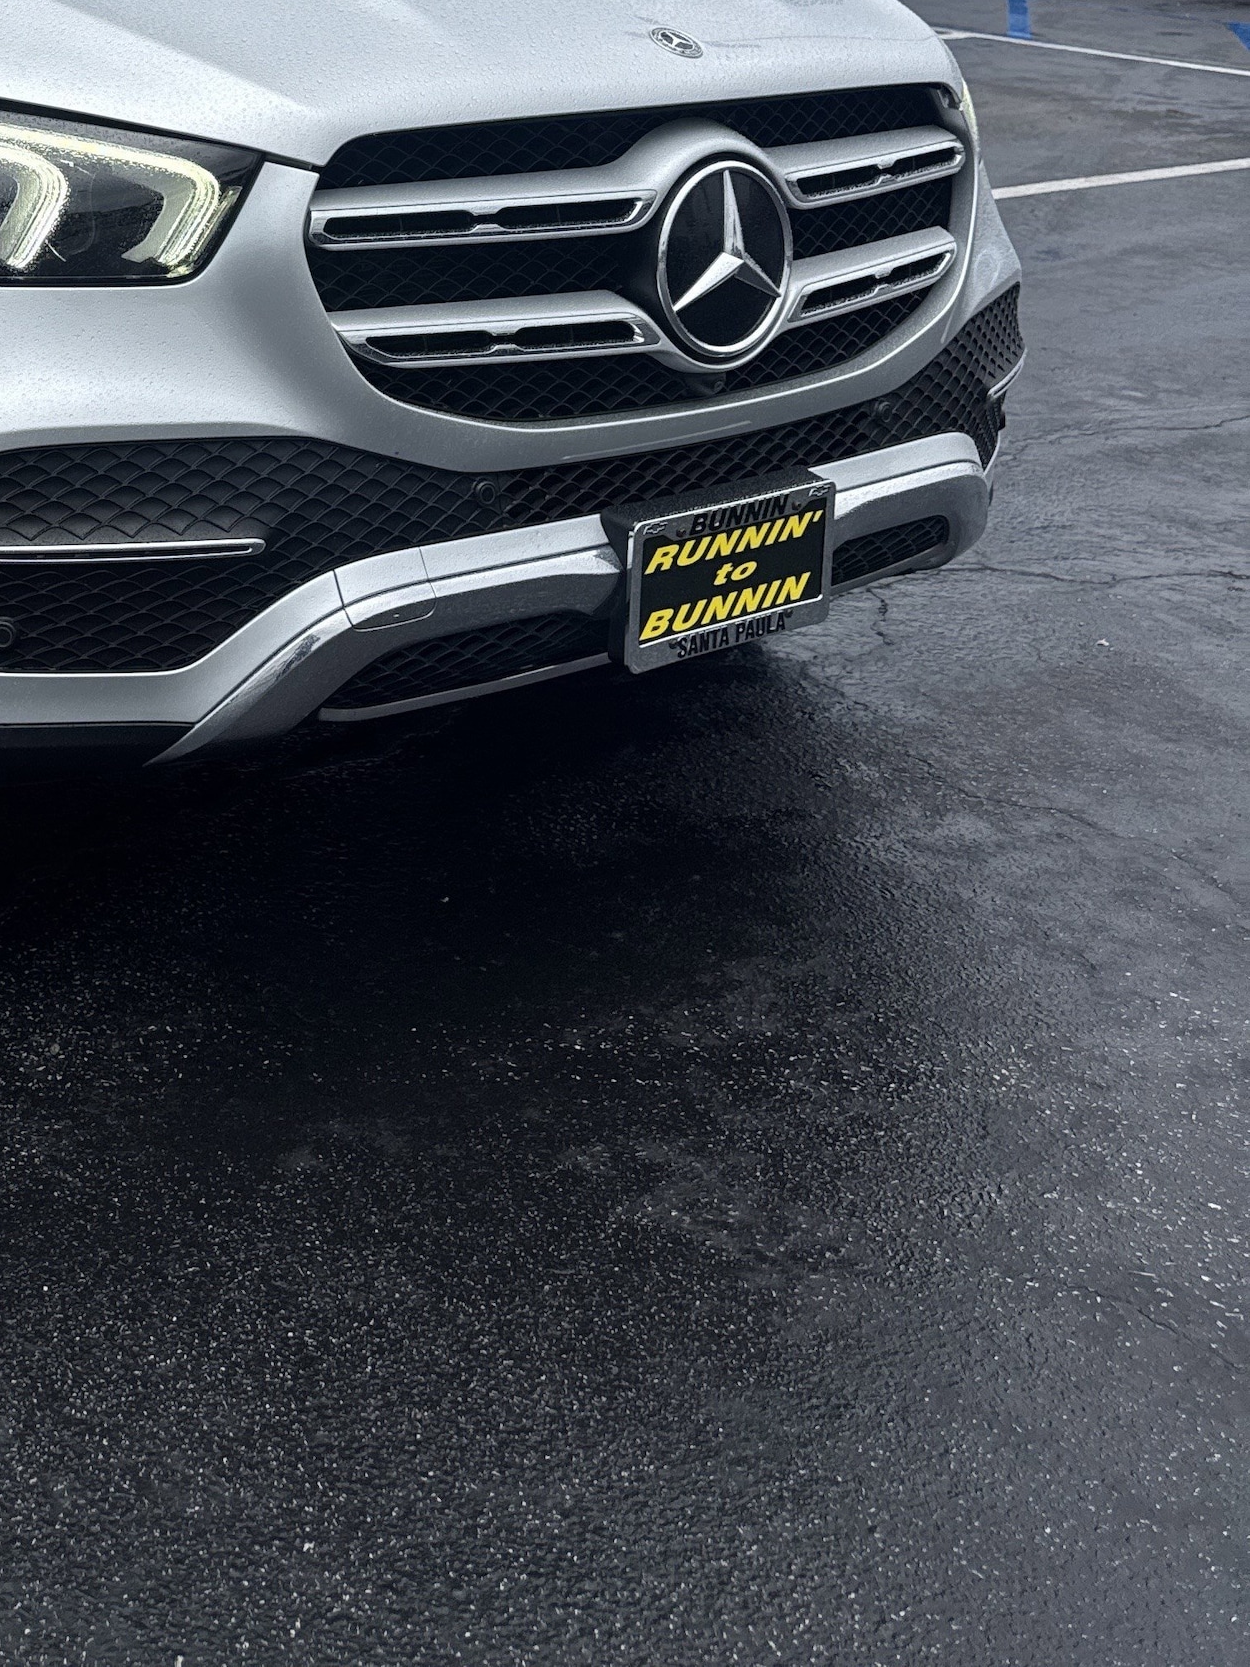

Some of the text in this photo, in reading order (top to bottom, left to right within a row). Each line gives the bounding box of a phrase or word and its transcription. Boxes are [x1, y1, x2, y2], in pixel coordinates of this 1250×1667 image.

[690, 493, 790, 535] BUNNIN
[644, 509, 823, 575] RUNNIN'
[713, 560, 758, 586] to
[639, 571, 812, 642] BUNNIN
[677, 611, 786, 659] SANTA PAULA
